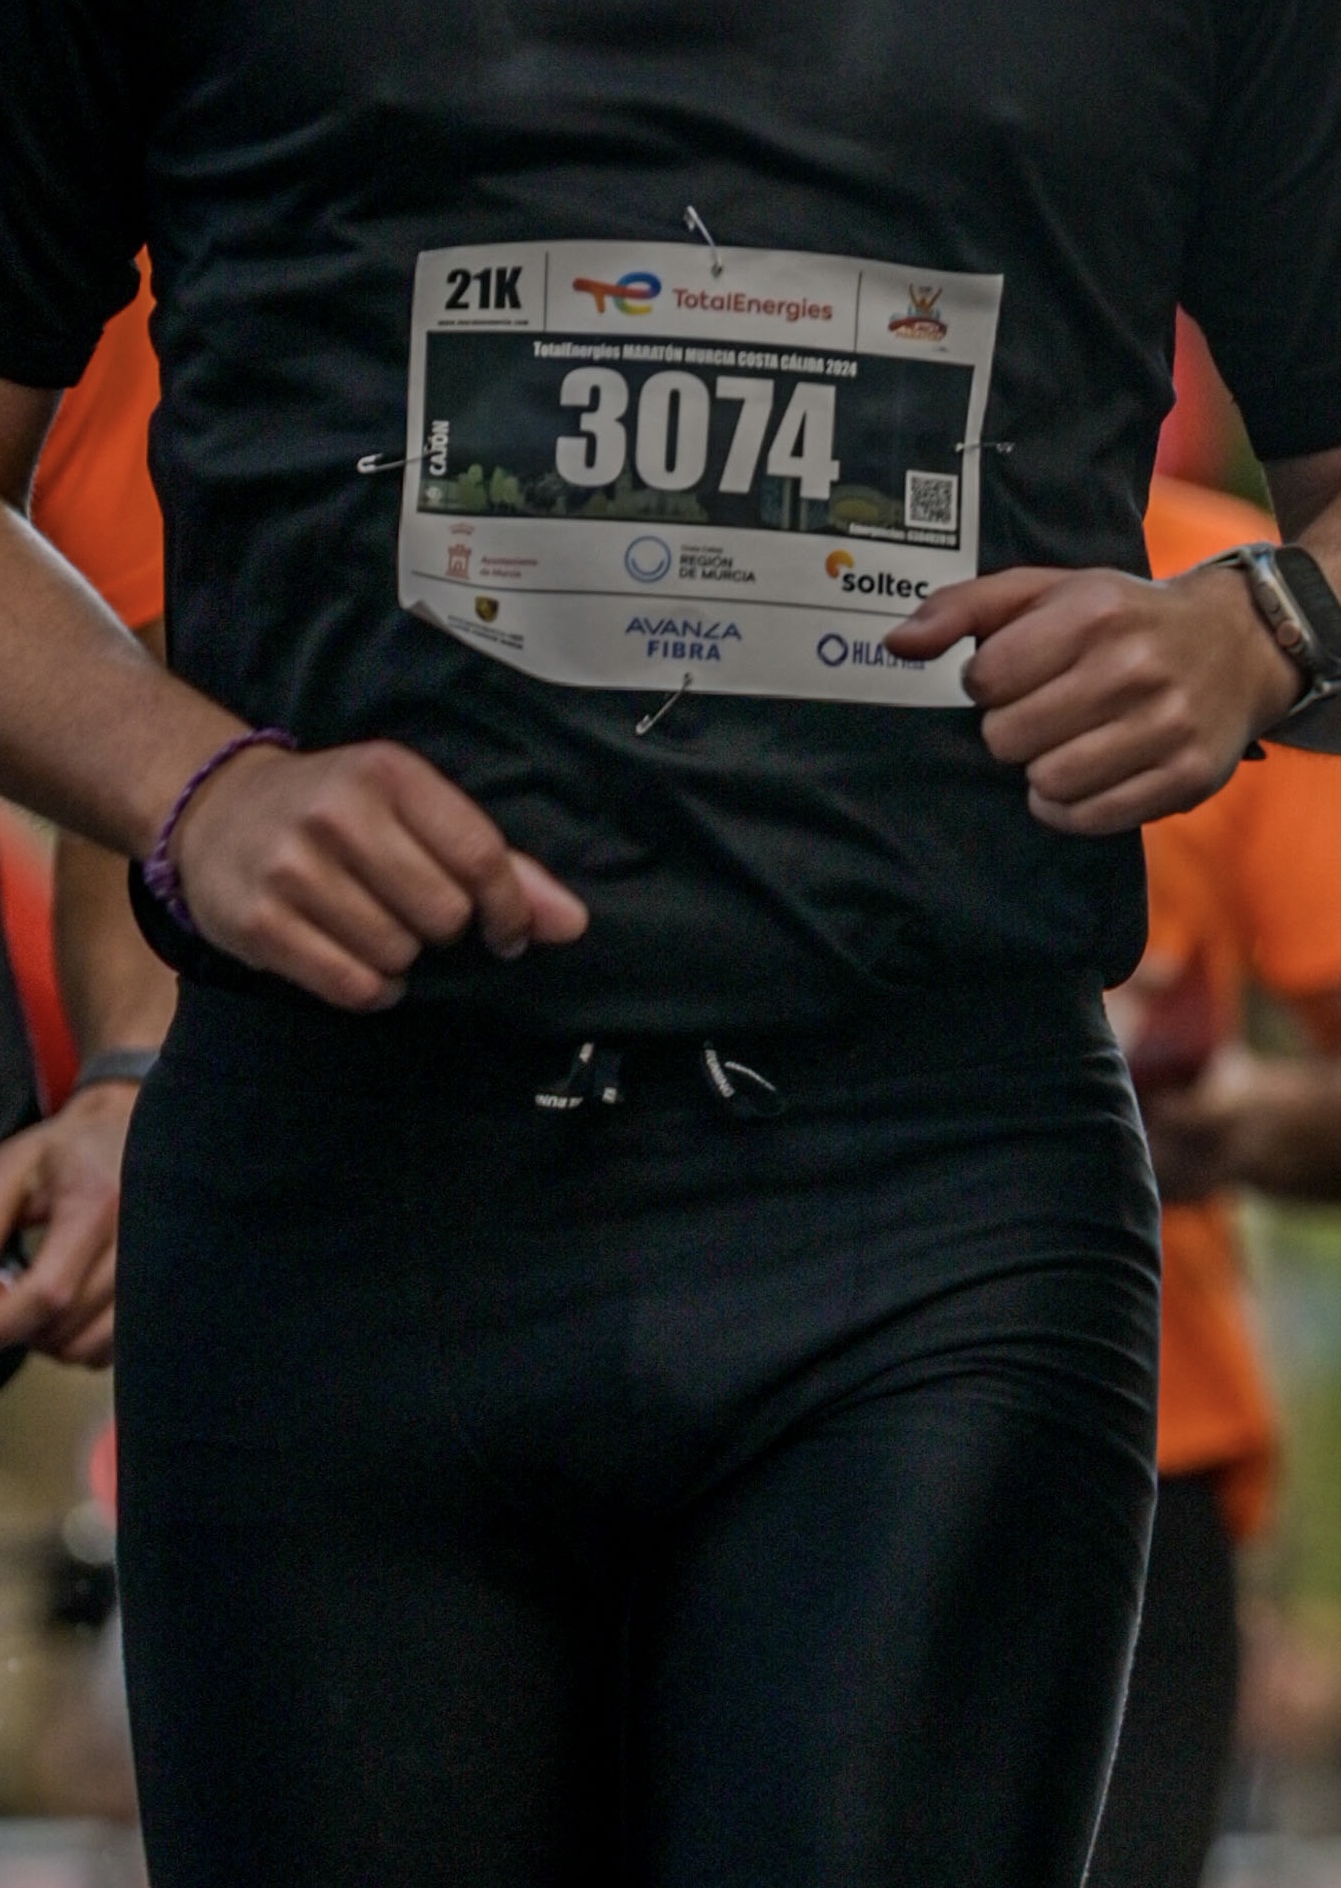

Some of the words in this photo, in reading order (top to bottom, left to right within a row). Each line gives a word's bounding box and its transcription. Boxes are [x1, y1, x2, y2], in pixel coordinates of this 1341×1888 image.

[445, 266, 522, 310] 21K
[673, 288, 833, 322] TotalEnergies
[533, 341, 621, 361] TotalEnergies
[684, 347, 736, 366] MURCIA
[737, 351, 778, 370] COSTA
[825, 358, 858, 378] 2024
[555, 366, 841, 501] 3074
[701, 569, 756, 583] MURCIA
[842, 572, 930, 600] soltec
[625, 617, 743, 641] AVANZA
[646, 640, 722, 662] FIBRA
